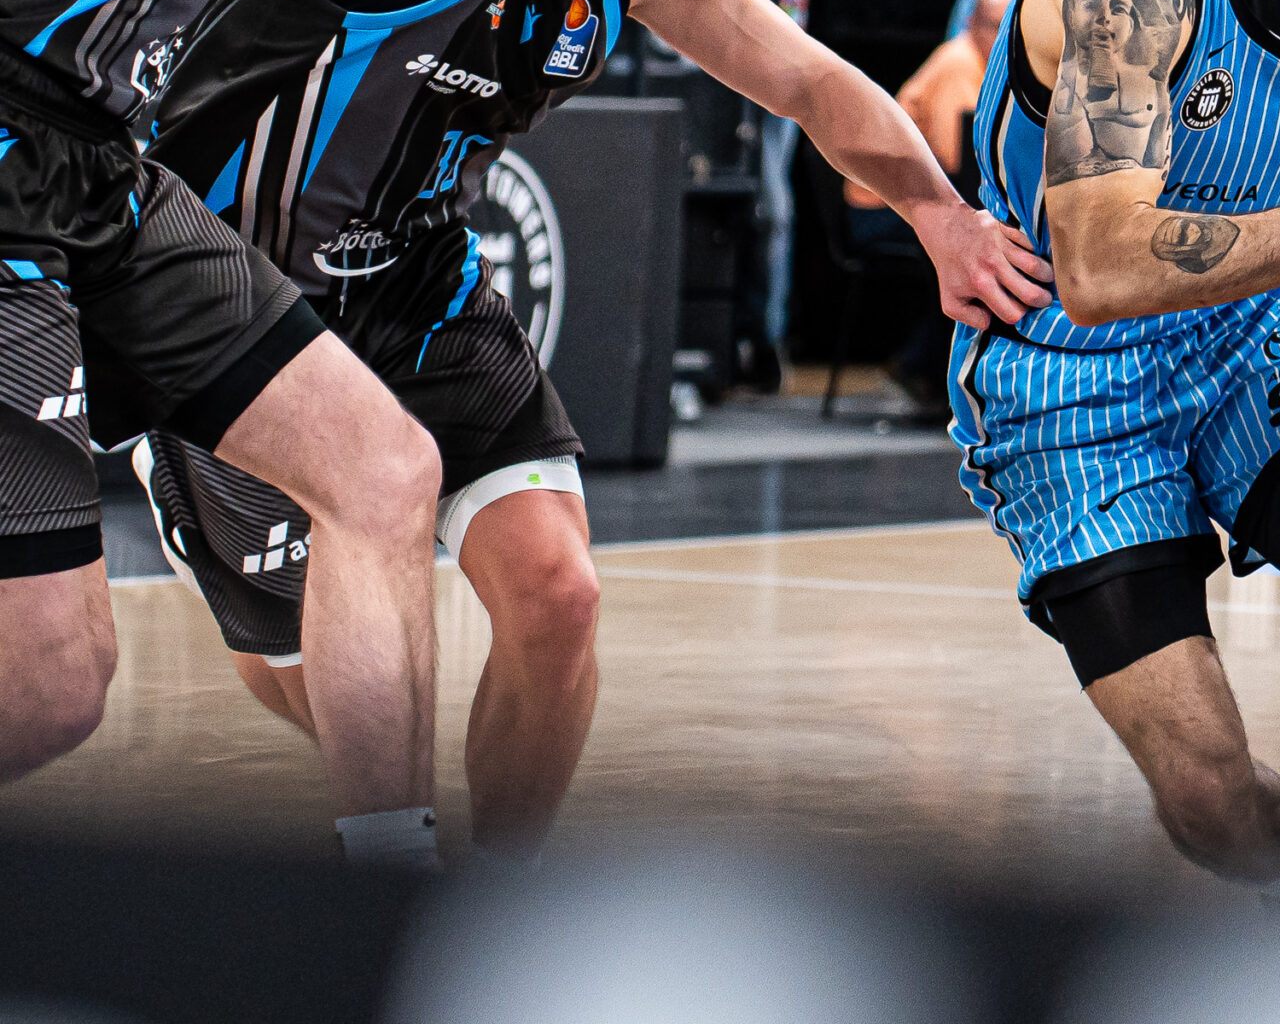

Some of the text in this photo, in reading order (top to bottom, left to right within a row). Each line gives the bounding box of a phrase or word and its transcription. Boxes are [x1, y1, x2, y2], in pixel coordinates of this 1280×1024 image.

[548, 50, 580, 71] BBL
[433, 62, 500, 98] LOTTO
[1162, 182, 1258, 202] VEOLIA
